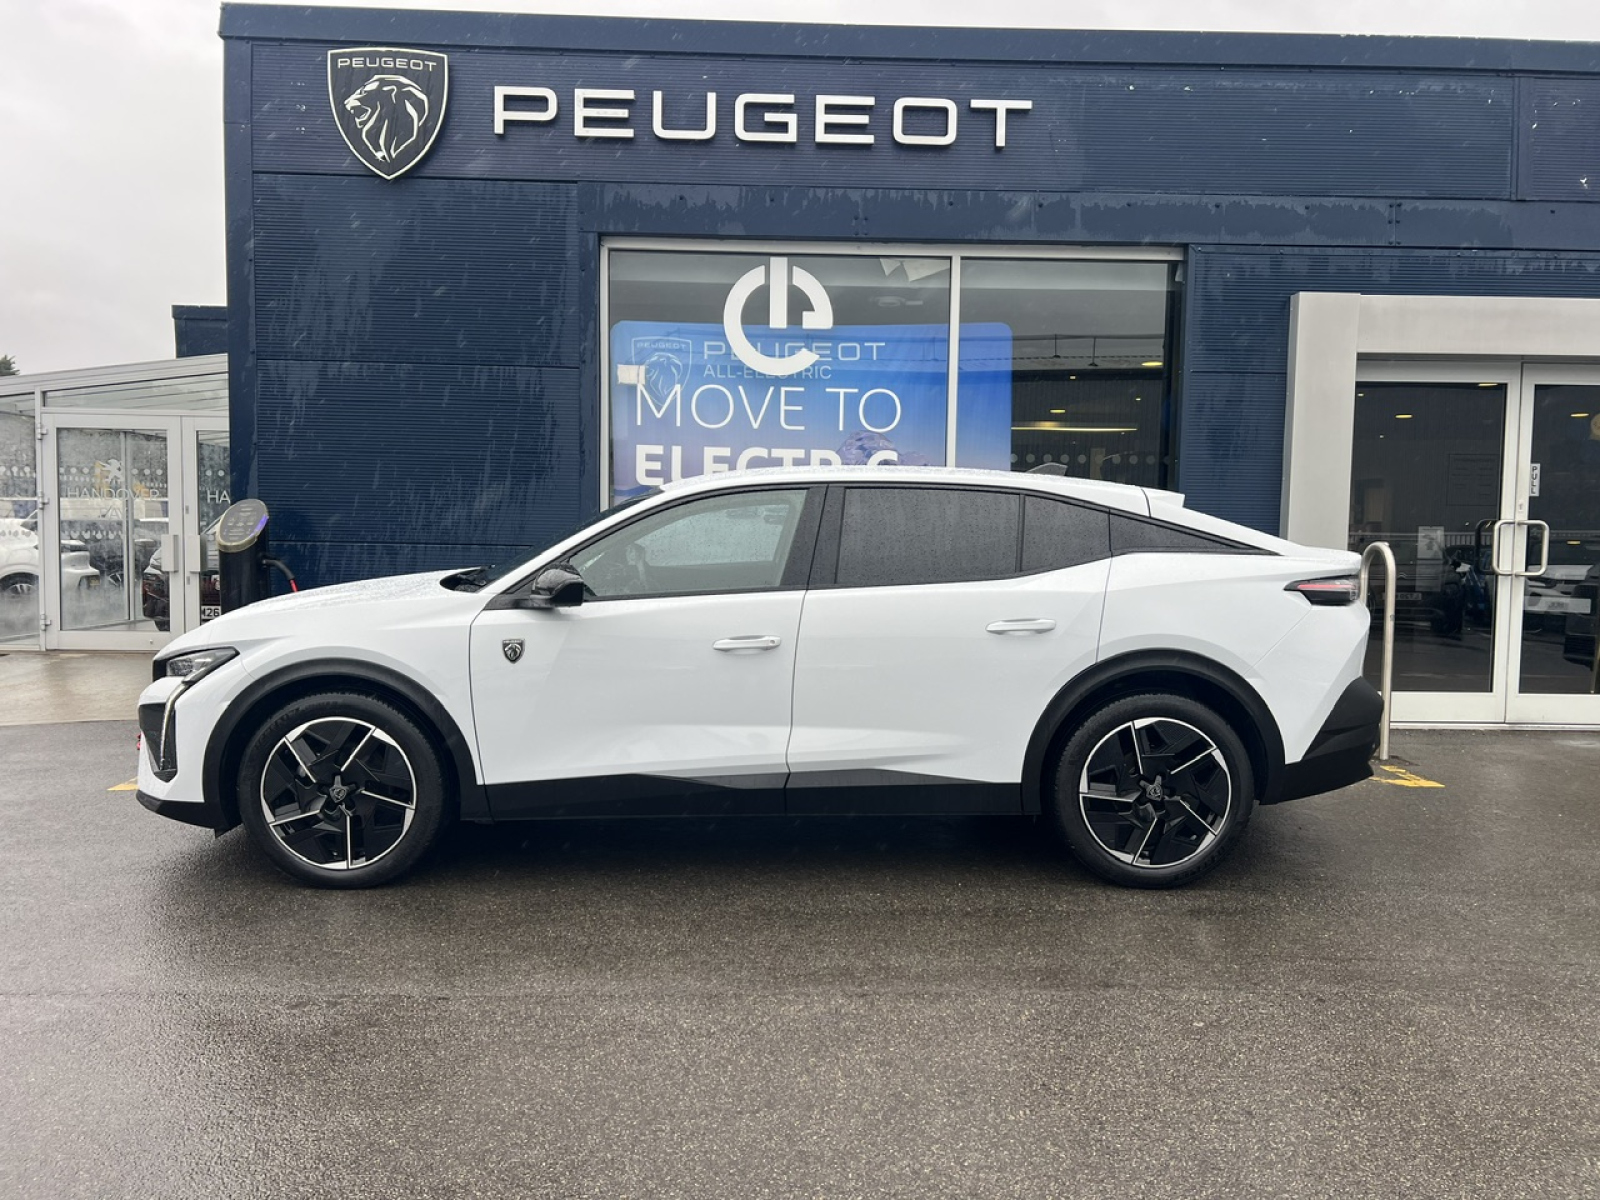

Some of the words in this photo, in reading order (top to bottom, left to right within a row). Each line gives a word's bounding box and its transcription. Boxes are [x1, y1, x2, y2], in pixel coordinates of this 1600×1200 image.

[337, 57, 437, 72] PEUGEOT
[493, 86, 1033, 149] PEUGEOT
[704, 341, 886, 361] PUGEOT
[704, 363, 832, 380] ALL-ELRIC
[636, 383, 806, 431] MOVE
[825, 387, 902, 433] TO
[67, 487, 160, 500] HANDOVER
